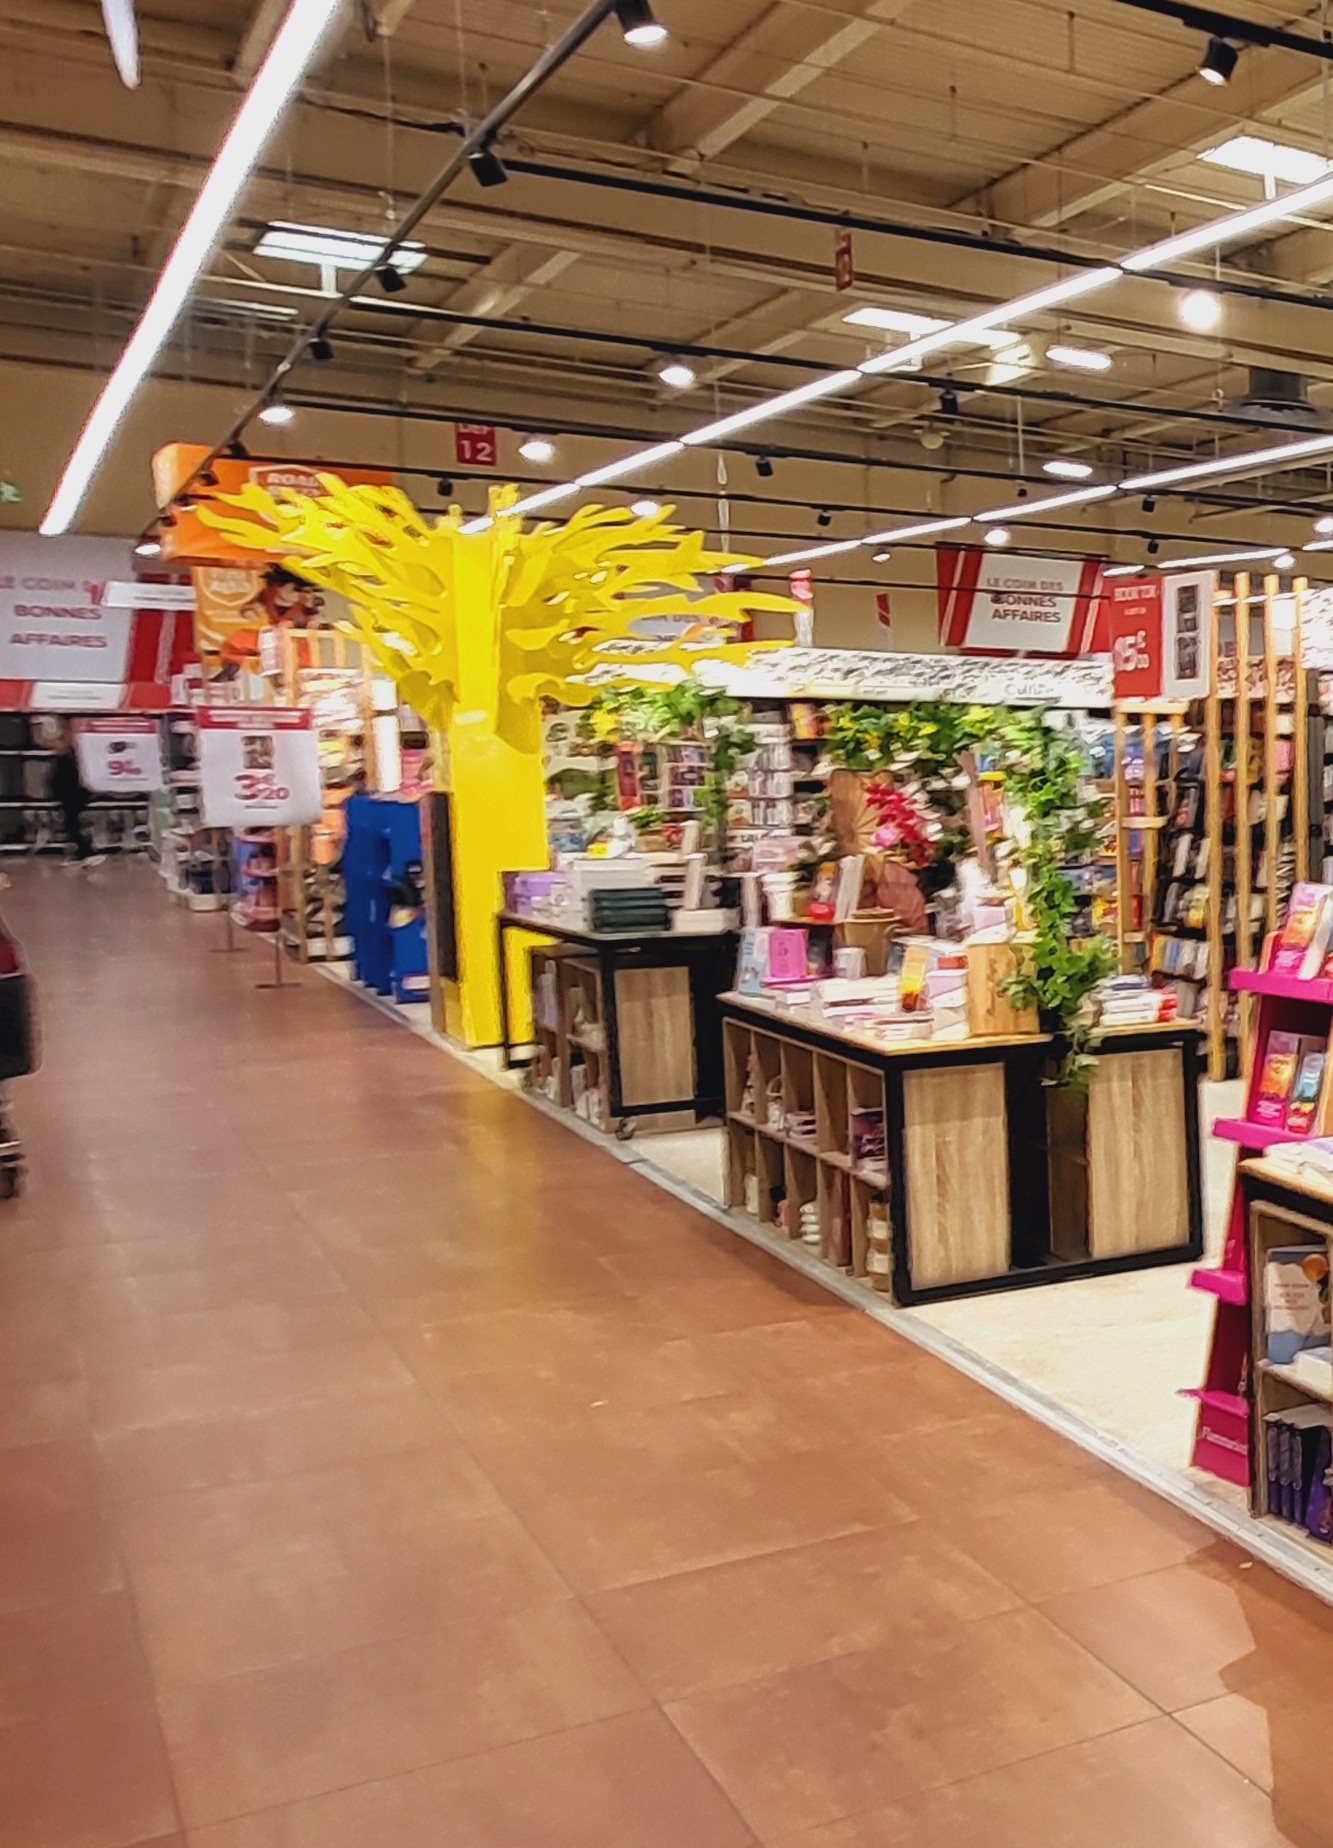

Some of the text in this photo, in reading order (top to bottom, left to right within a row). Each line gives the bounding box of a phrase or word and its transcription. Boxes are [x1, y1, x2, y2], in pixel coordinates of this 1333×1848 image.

[460, 440, 492, 461] 12
[987, 577, 998, 588] LE
[1040, 579, 1064, 591] DES
[14, 604, 101, 620] BONNES
[991, 608, 1061, 623] AFFAIRES
[10, 632, 107, 648] AFFAIRES
